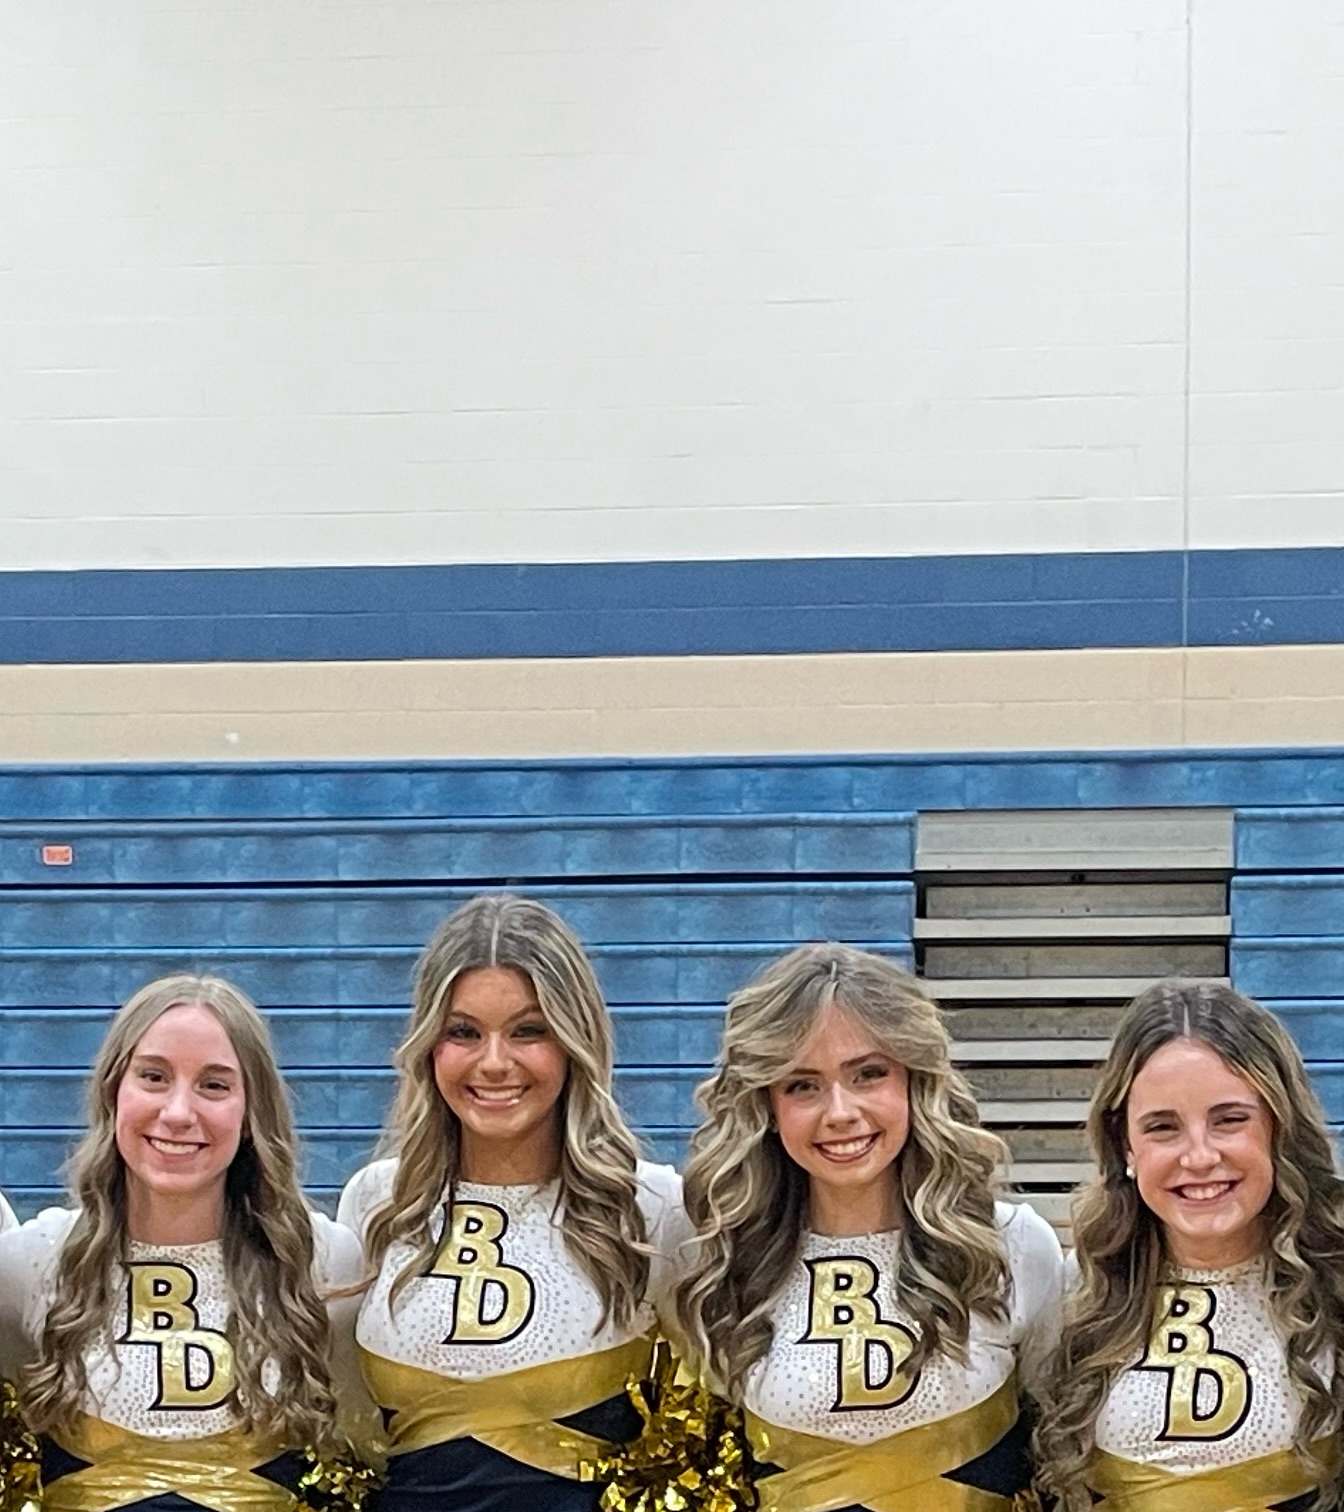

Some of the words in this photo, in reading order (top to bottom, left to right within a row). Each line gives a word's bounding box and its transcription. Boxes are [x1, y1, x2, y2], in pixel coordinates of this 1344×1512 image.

[114, 1261, 238, 1412] BD
[421, 1200, 536, 1345] BD
[795, 1255, 922, 1413] BD
[1129, 1281, 1253, 1442] BD
